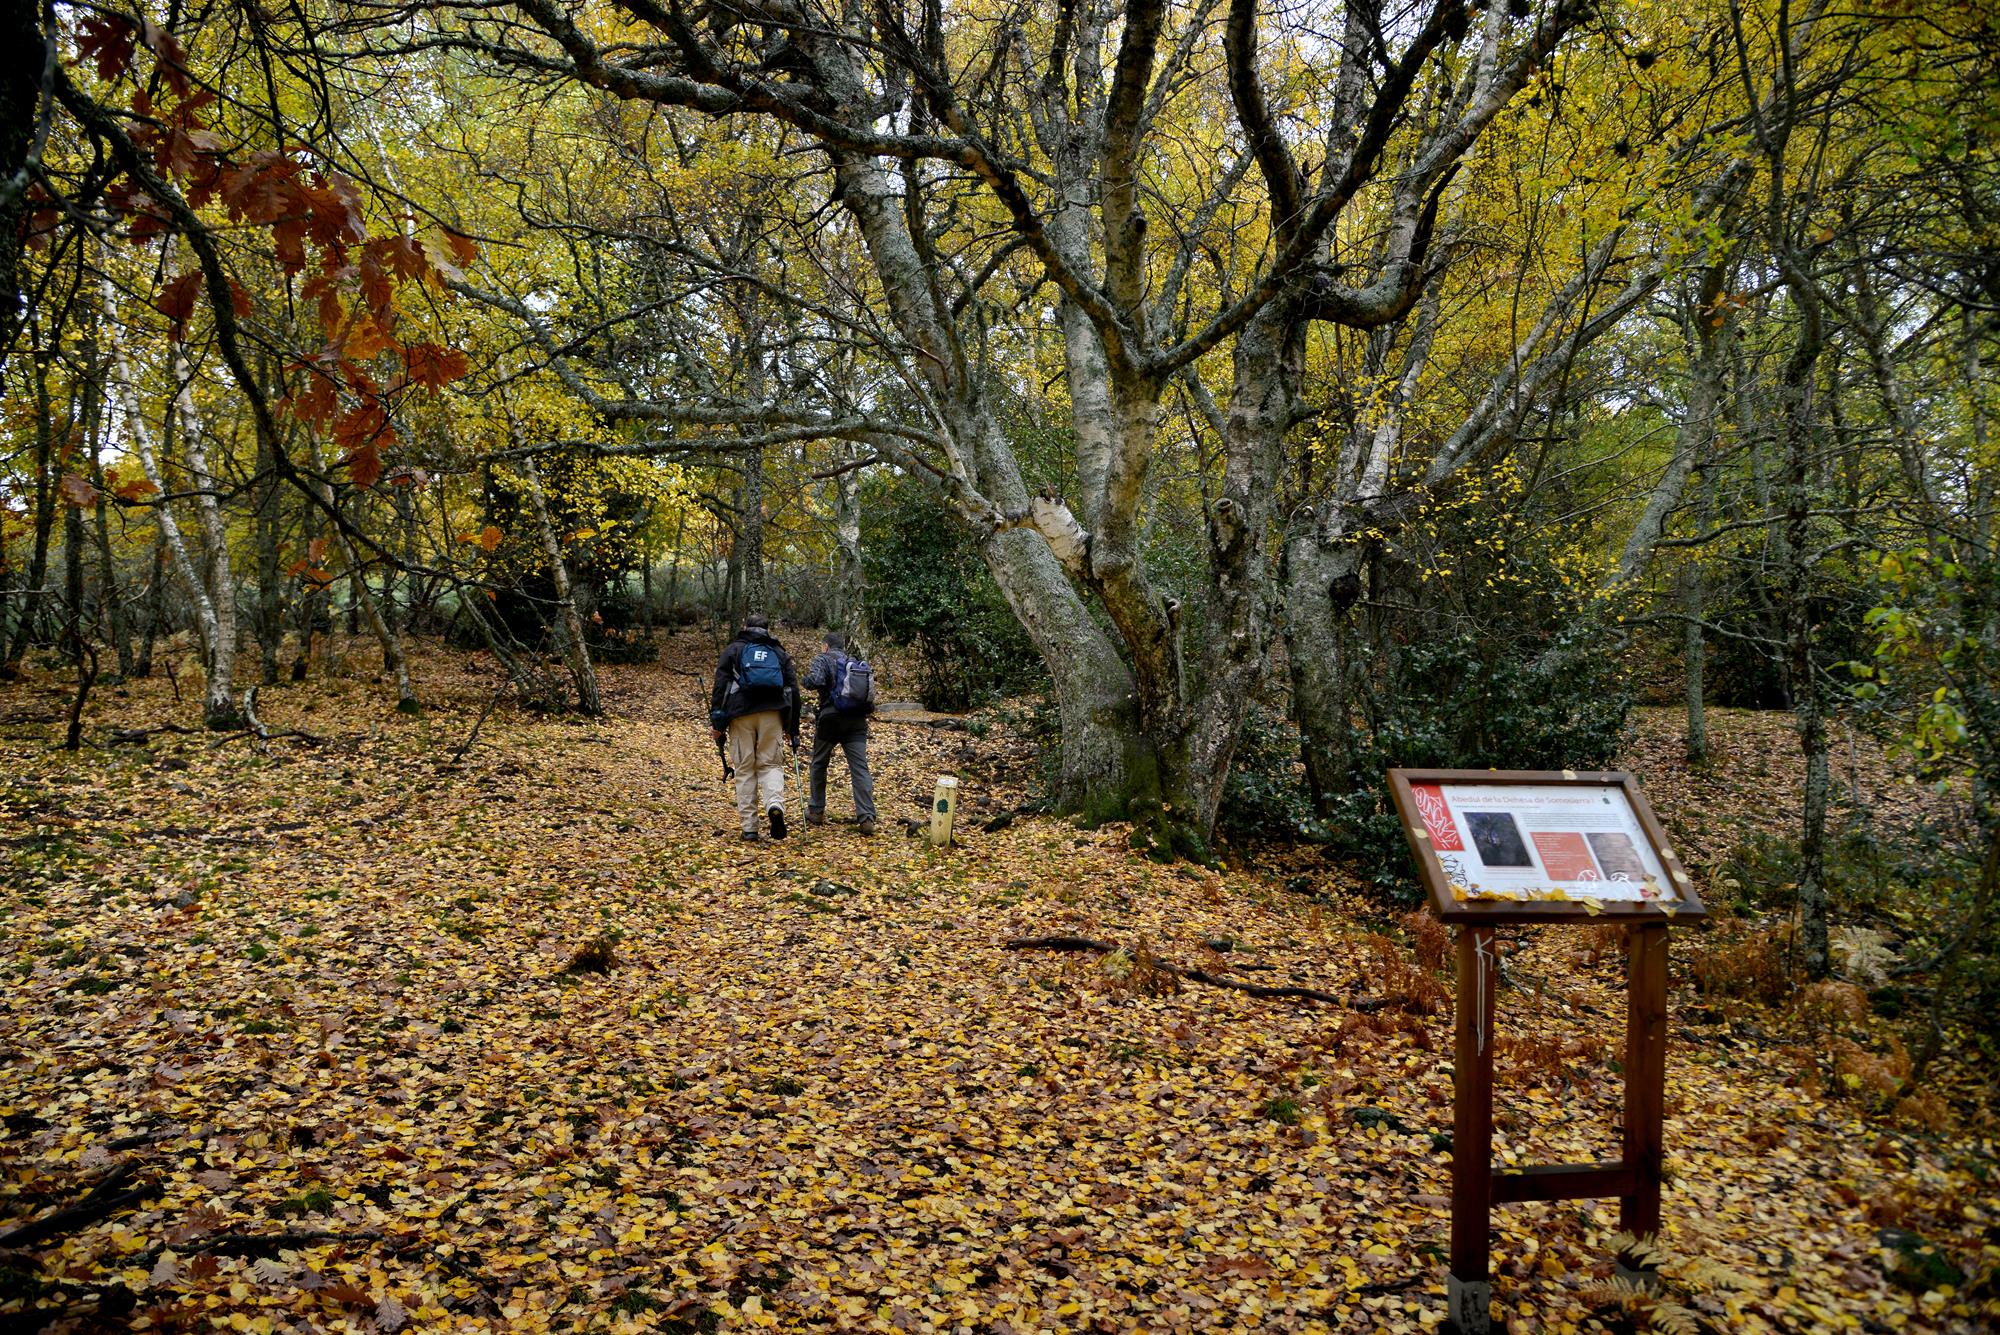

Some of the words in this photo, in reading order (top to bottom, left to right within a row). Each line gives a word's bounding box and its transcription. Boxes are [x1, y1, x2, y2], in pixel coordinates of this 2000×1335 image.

[754, 650, 768, 662] EF
[1451, 795, 1480, 803] Abedul
[1534, 796, 1544, 804] de
